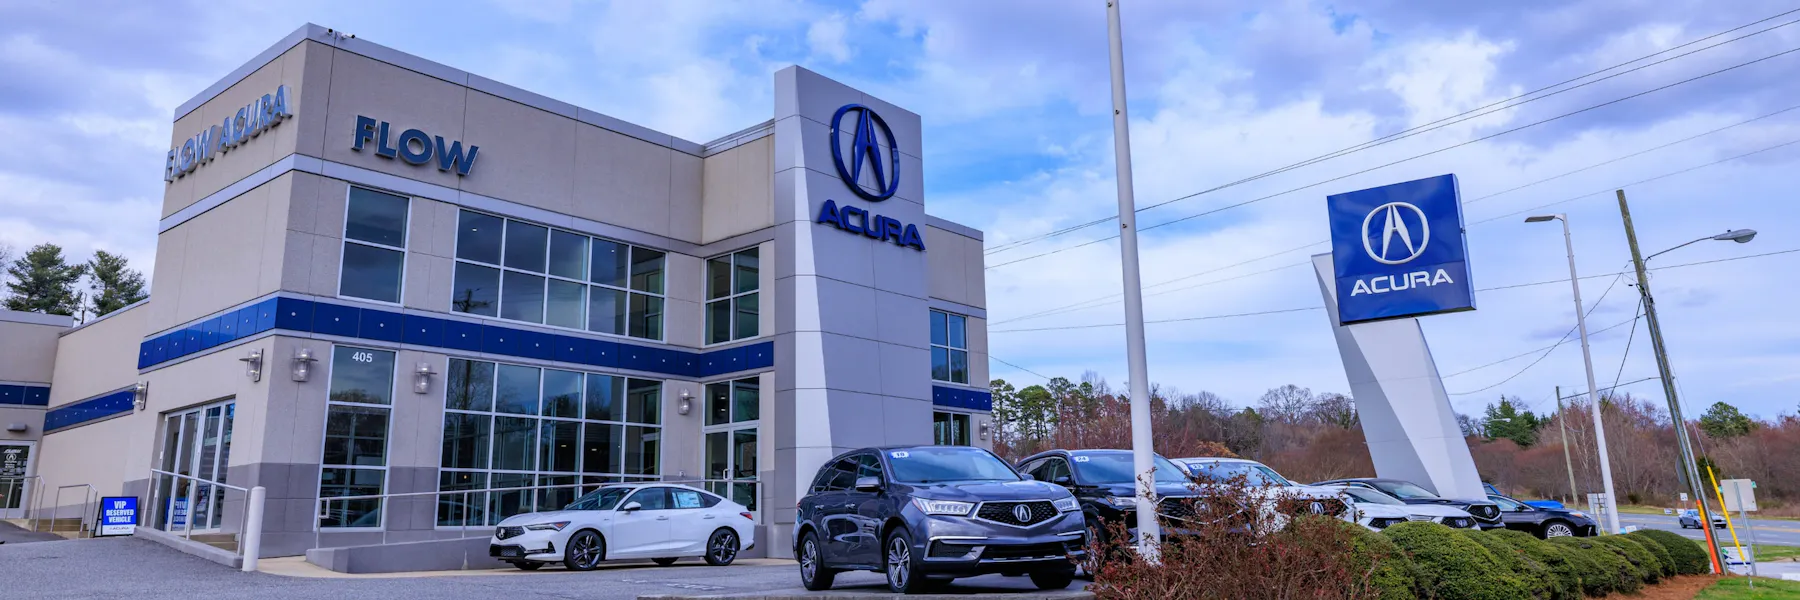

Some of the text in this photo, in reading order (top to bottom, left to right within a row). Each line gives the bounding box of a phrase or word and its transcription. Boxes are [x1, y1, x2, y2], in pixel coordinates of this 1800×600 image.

[164, 84, 293, 182] FLOW ACURA
[351, 114, 480, 176] FLOW
[816, 199, 926, 252] ACURA
[1350, 268, 1454, 297] ACURA
[352, 351, 373, 363] 405
[106, 509, 135, 517] RESERVED
[113, 500, 127, 509] VIP
